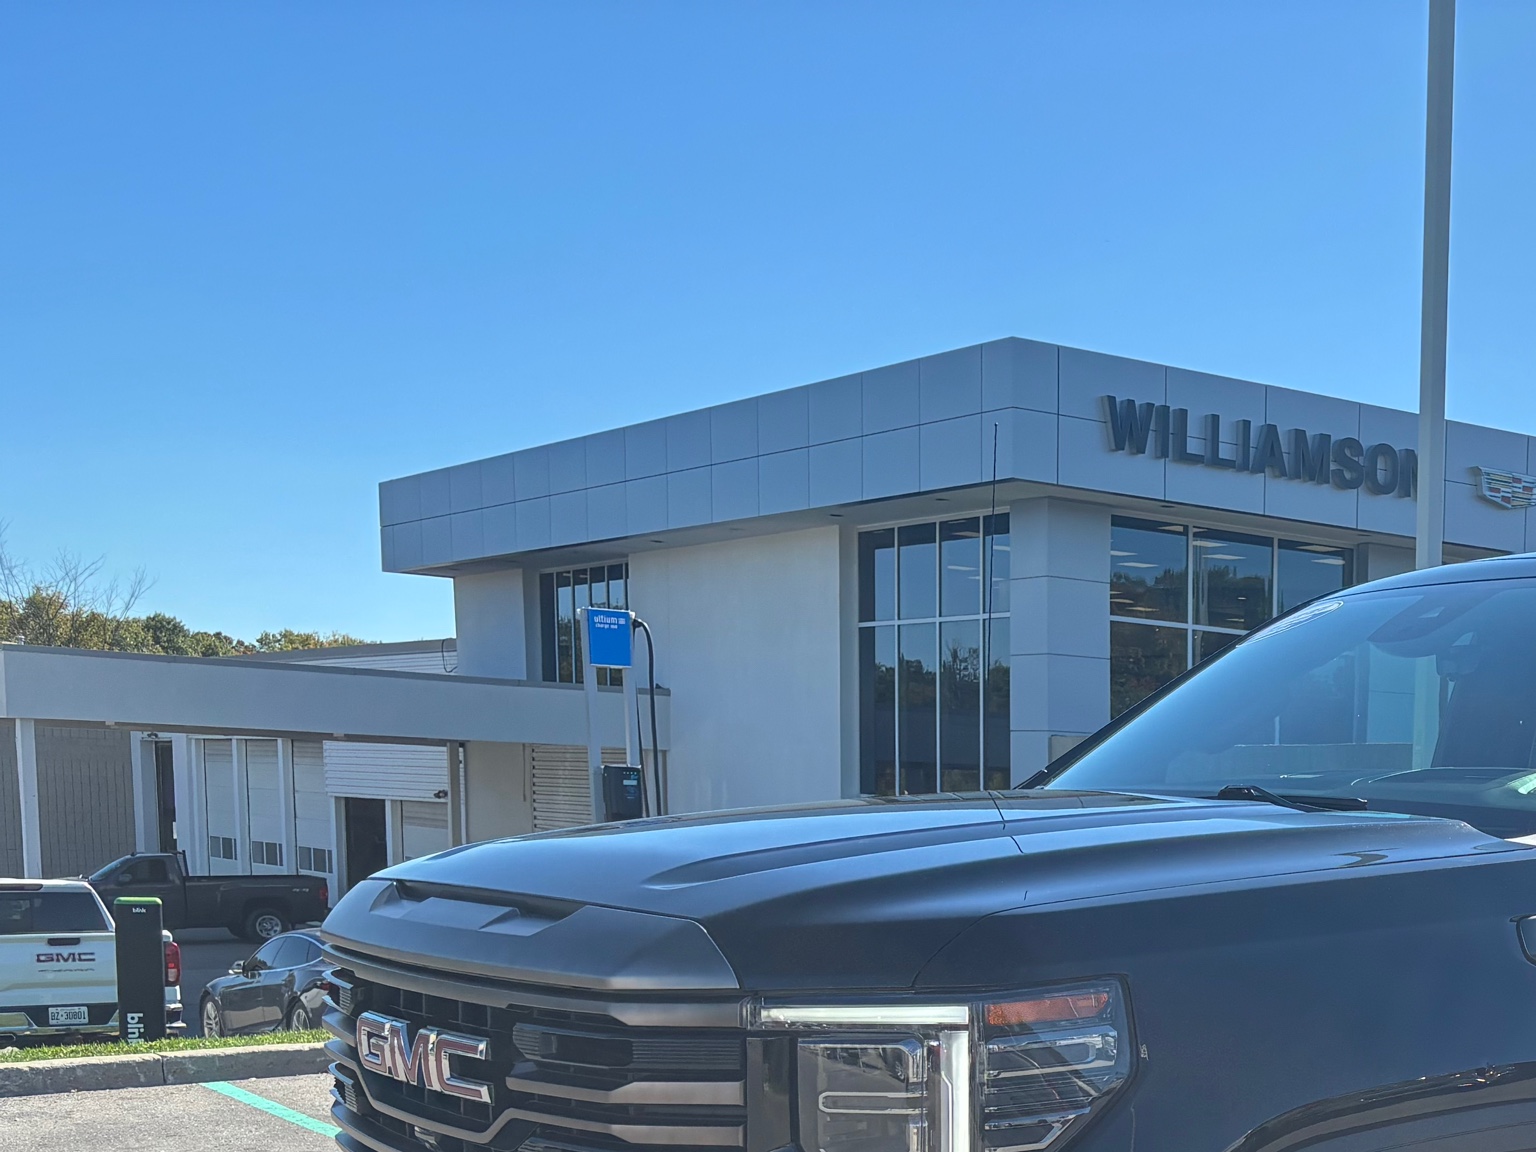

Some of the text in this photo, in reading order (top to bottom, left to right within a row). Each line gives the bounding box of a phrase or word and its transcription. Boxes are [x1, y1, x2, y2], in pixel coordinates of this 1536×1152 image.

[593, 615, 617, 624] ultium
[36, 952, 96, 963] GMC
[356, 1010, 492, 1104] GMC
